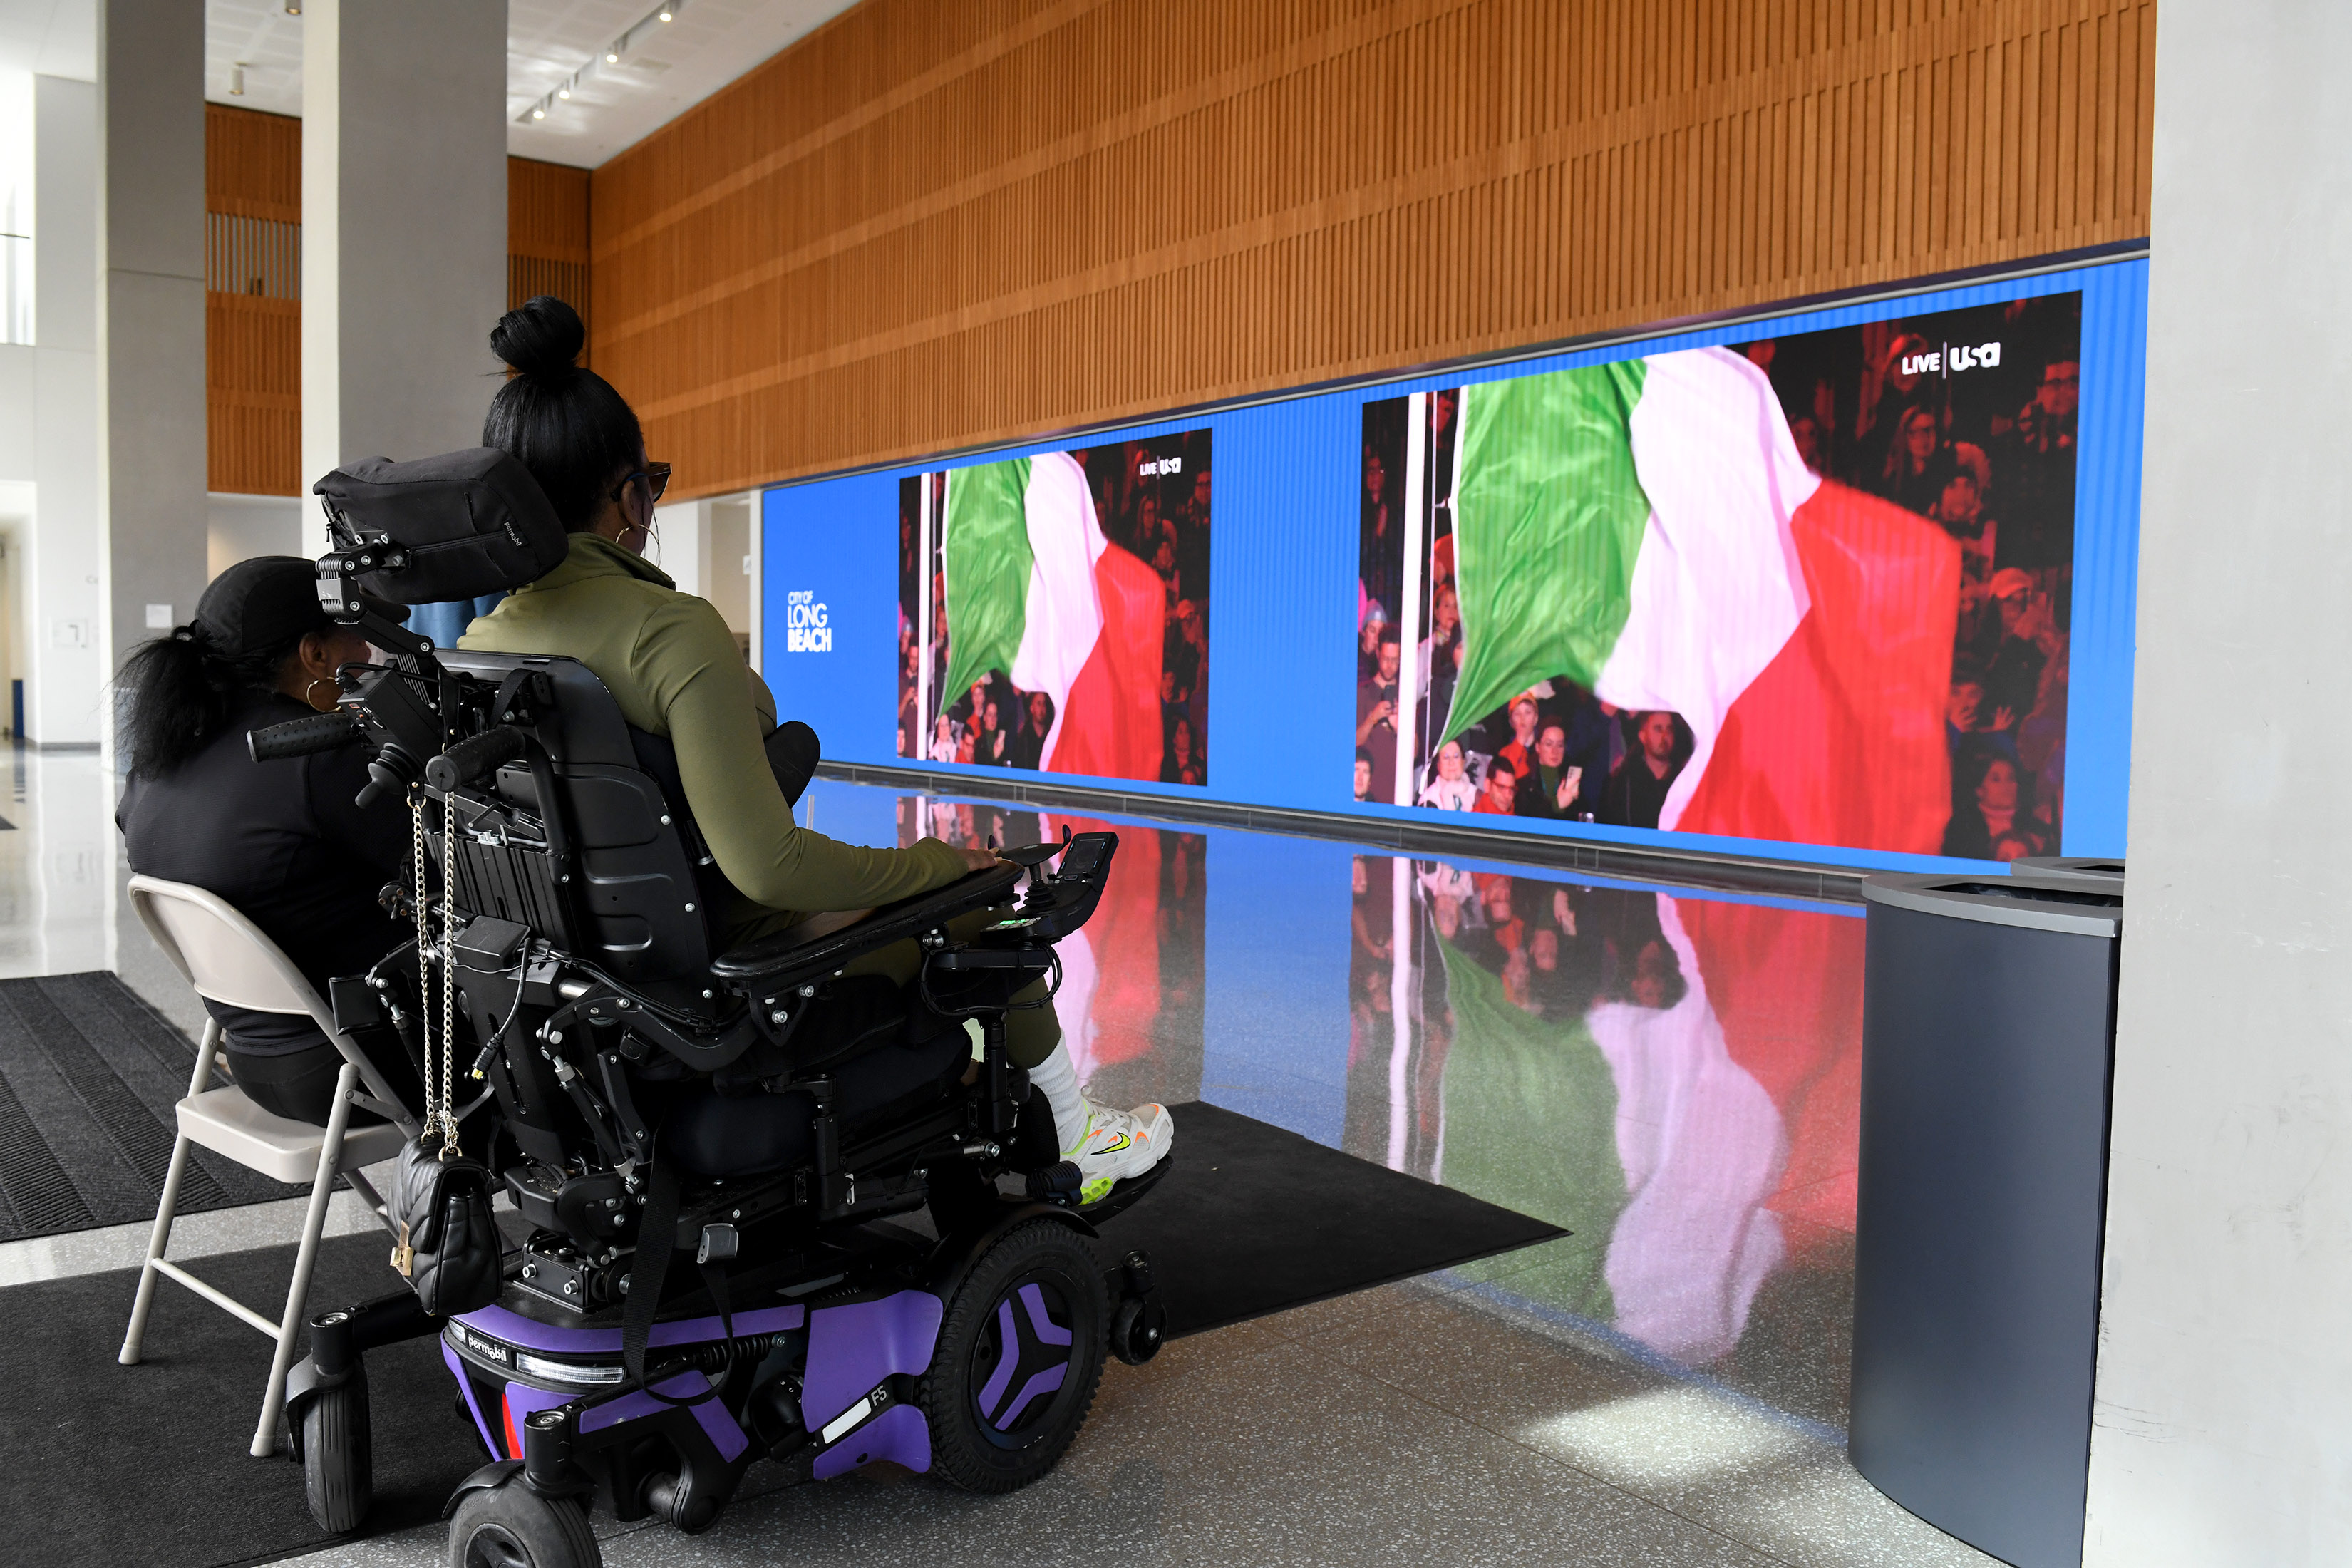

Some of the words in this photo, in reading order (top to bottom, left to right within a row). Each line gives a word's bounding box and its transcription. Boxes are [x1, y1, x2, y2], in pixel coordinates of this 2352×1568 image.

[1902, 352, 1941, 375] LIVE
[1140, 462, 1157, 476] LIVE
[504, 522, 522, 546] permobil
[803, 590, 813, 604] OF
[788, 603, 827, 628] LONG
[788, 627, 832, 652] BEACH
[468, 1336, 507, 1362] permobil
[870, 1385, 888, 1407] F5
